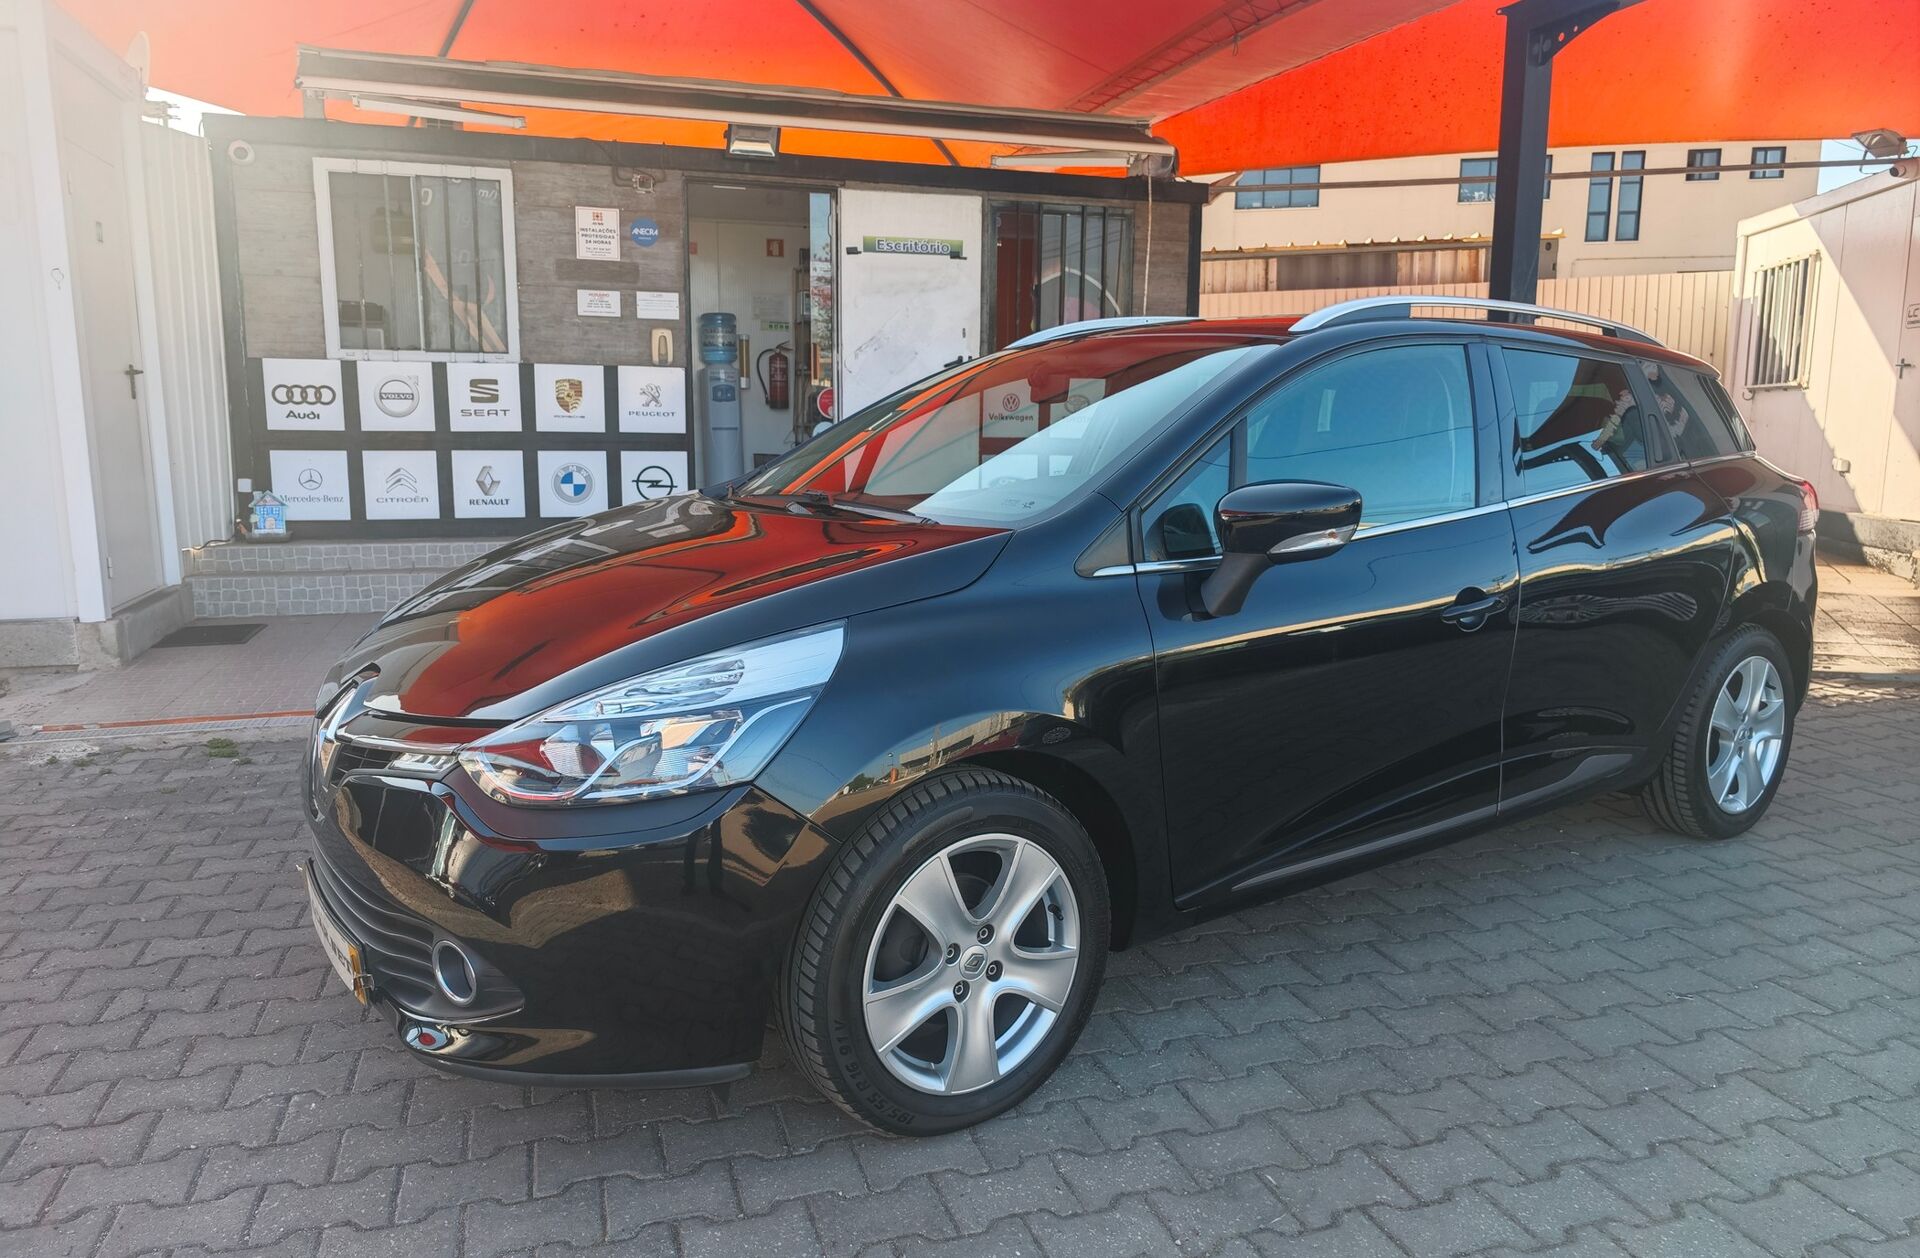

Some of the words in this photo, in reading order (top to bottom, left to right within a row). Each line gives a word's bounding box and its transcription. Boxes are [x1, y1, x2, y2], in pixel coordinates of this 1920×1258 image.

[631, 227, 659, 236] ANECRA
[876, 239, 951, 254] Escritório
[286, 410, 321, 420] Audi
[460, 409, 511, 417] SEAT
[988, 413, 1034, 422] Volkswagen
[280, 494, 344, 503] Mercedes-Benz
[376, 496, 429, 504] CITROËN
[469, 498, 511, 506] RENAULT
